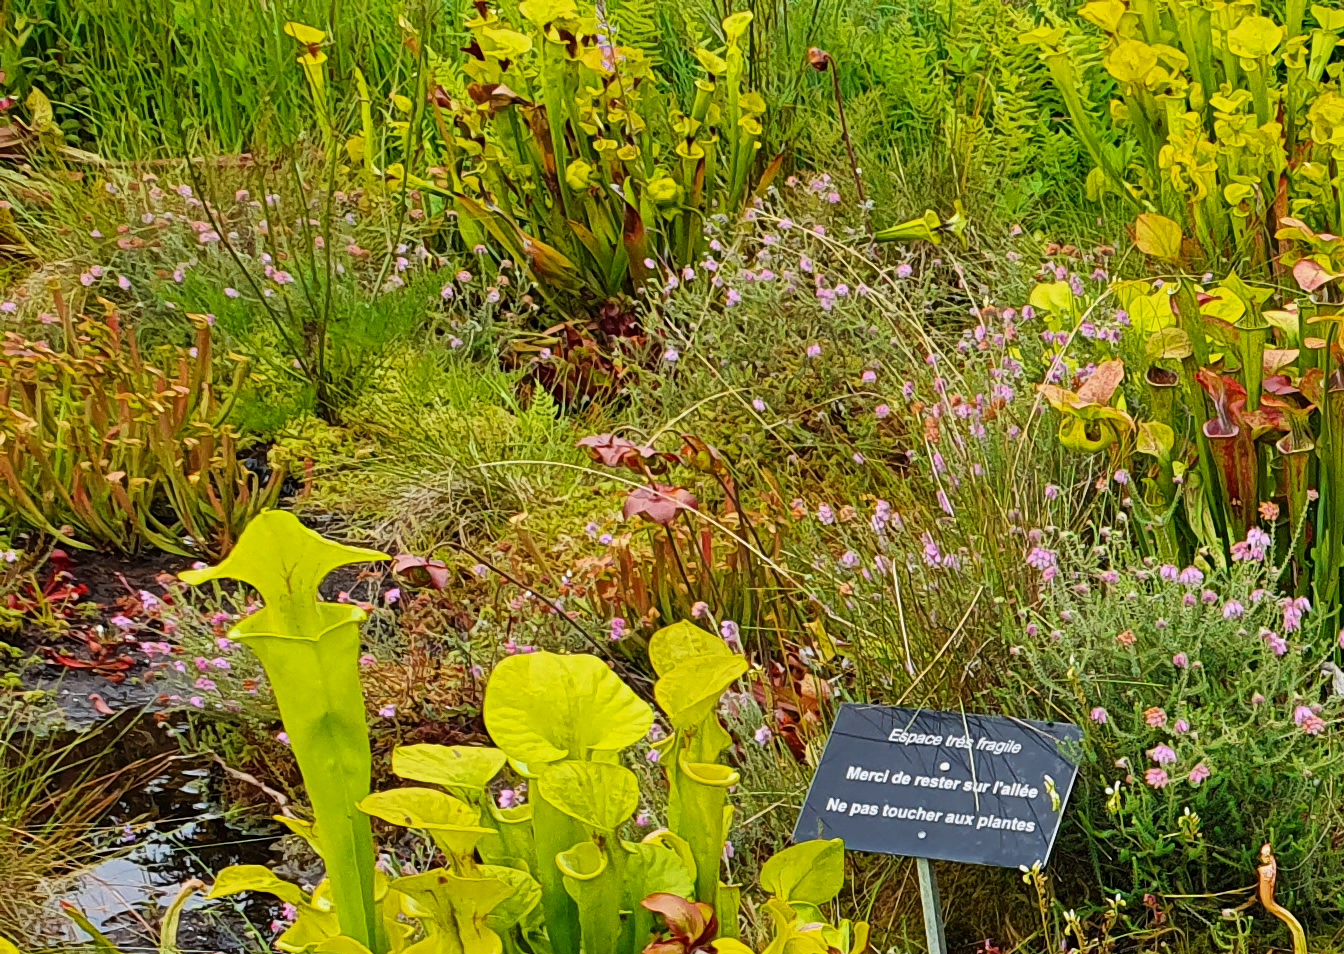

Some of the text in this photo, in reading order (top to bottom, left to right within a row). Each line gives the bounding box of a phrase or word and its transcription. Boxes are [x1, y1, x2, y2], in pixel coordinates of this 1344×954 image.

[888, 728, 943, 746] Espace
[976, 738, 1022, 755] fragile
[845, 766, 1038, 799] Merci de rester sur l'allée
[826, 797, 1036, 834] Ne pas toucher aux plantes
